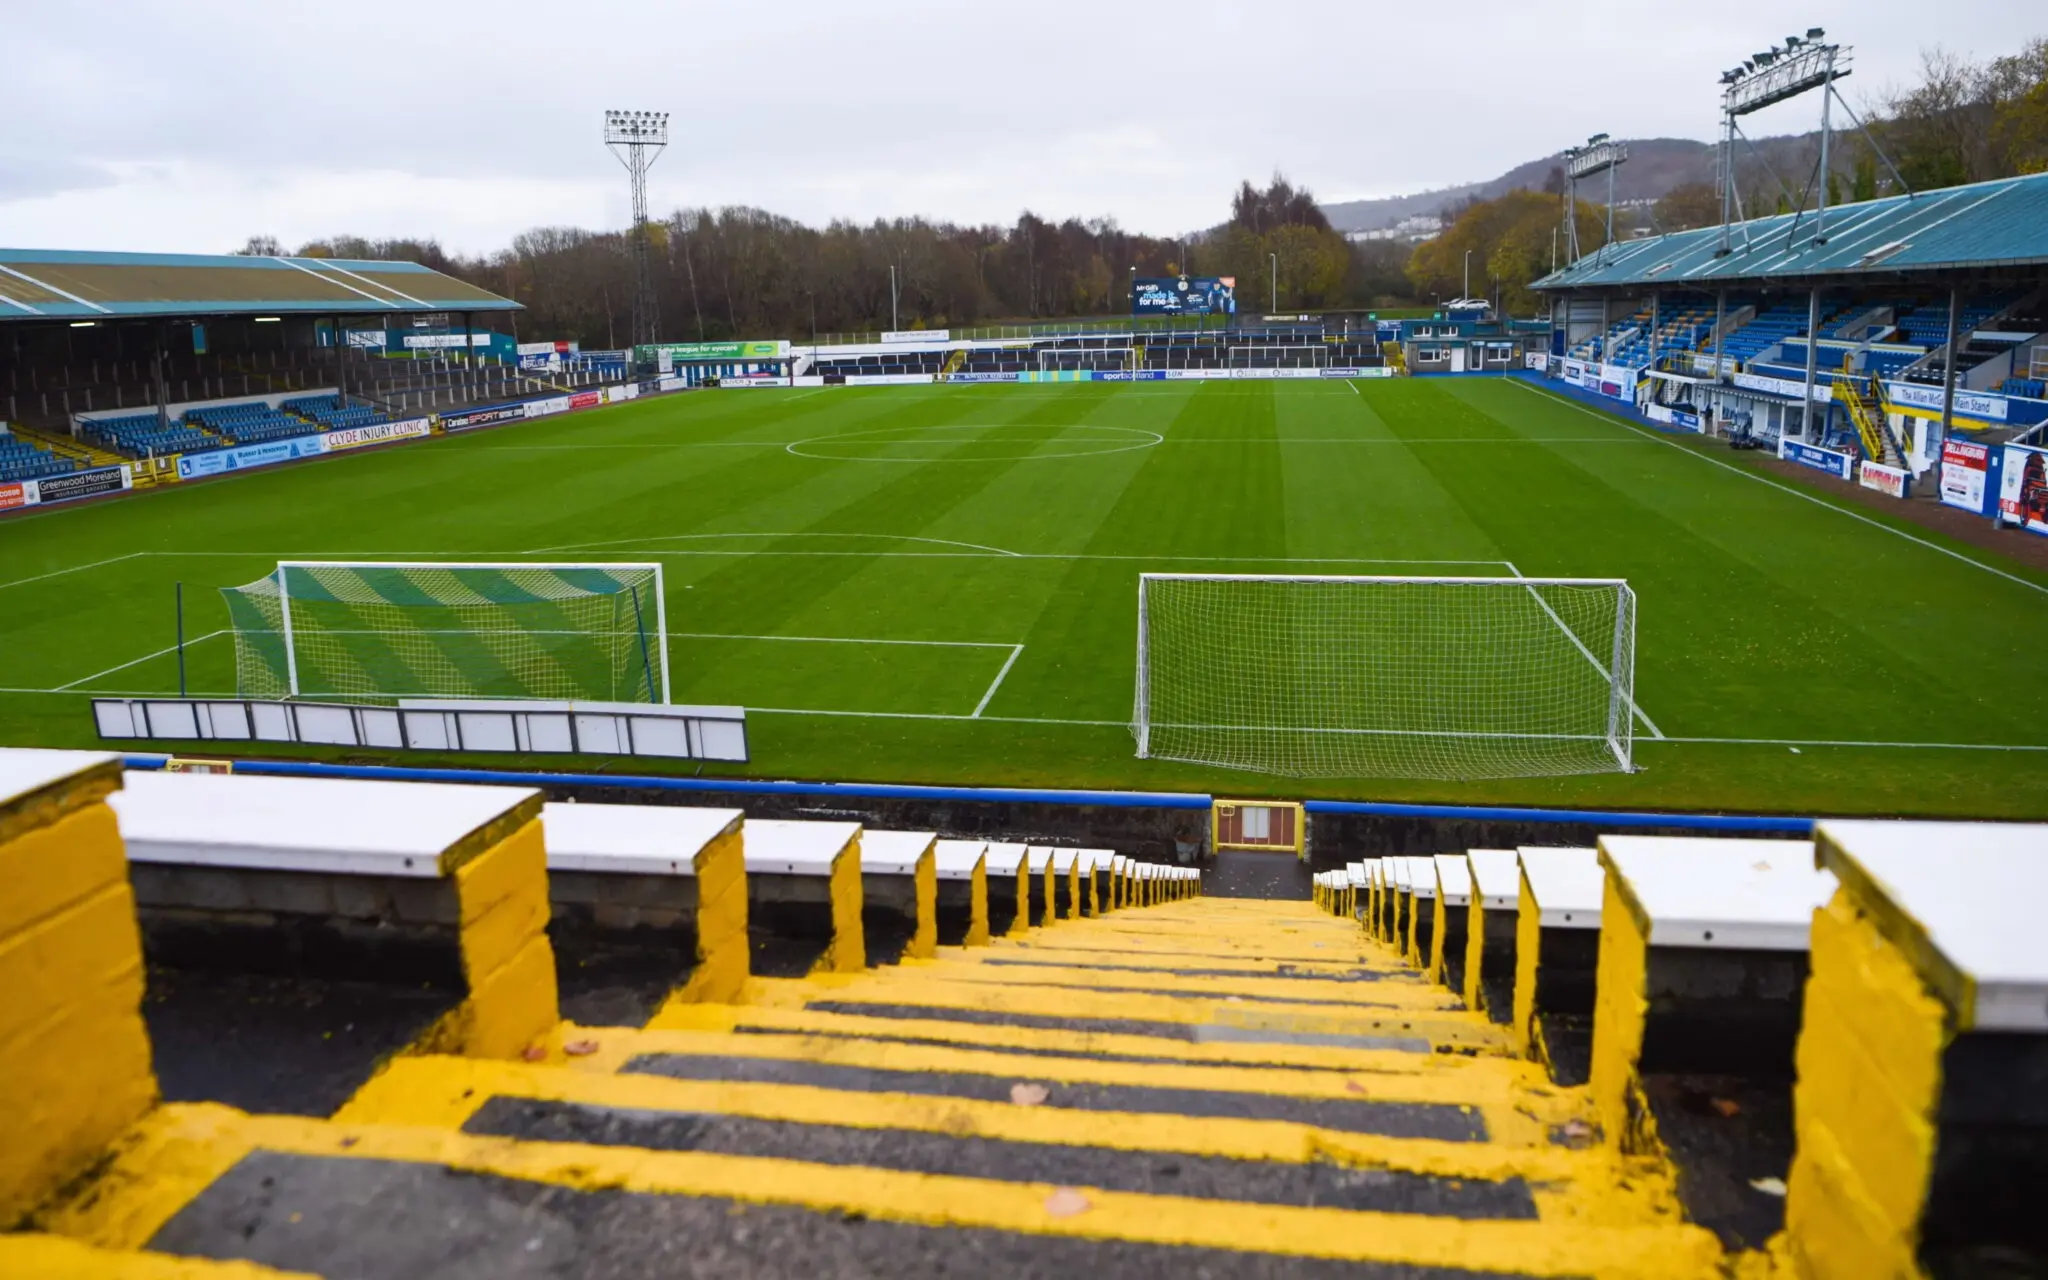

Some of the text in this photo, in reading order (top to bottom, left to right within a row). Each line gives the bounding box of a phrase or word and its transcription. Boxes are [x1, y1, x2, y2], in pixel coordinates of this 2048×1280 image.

[1139, 297, 1166, 306] for me
[1143, 291, 1167, 300] made
[676, 346, 699, 354] league
[711, 344, 738, 352] eyecare
[1901, 389, 1911, 400] The
[1913, 391, 1928, 404] Allan
[1954, 397, 1970, 410] Main
[1970, 399, 1991, 413] Stand
[468, 411, 499, 424] SPORT
[328, 421, 422, 446] CLYDE INJURY CLINIC
[39, 469, 120, 492] Greenwood Moreland
